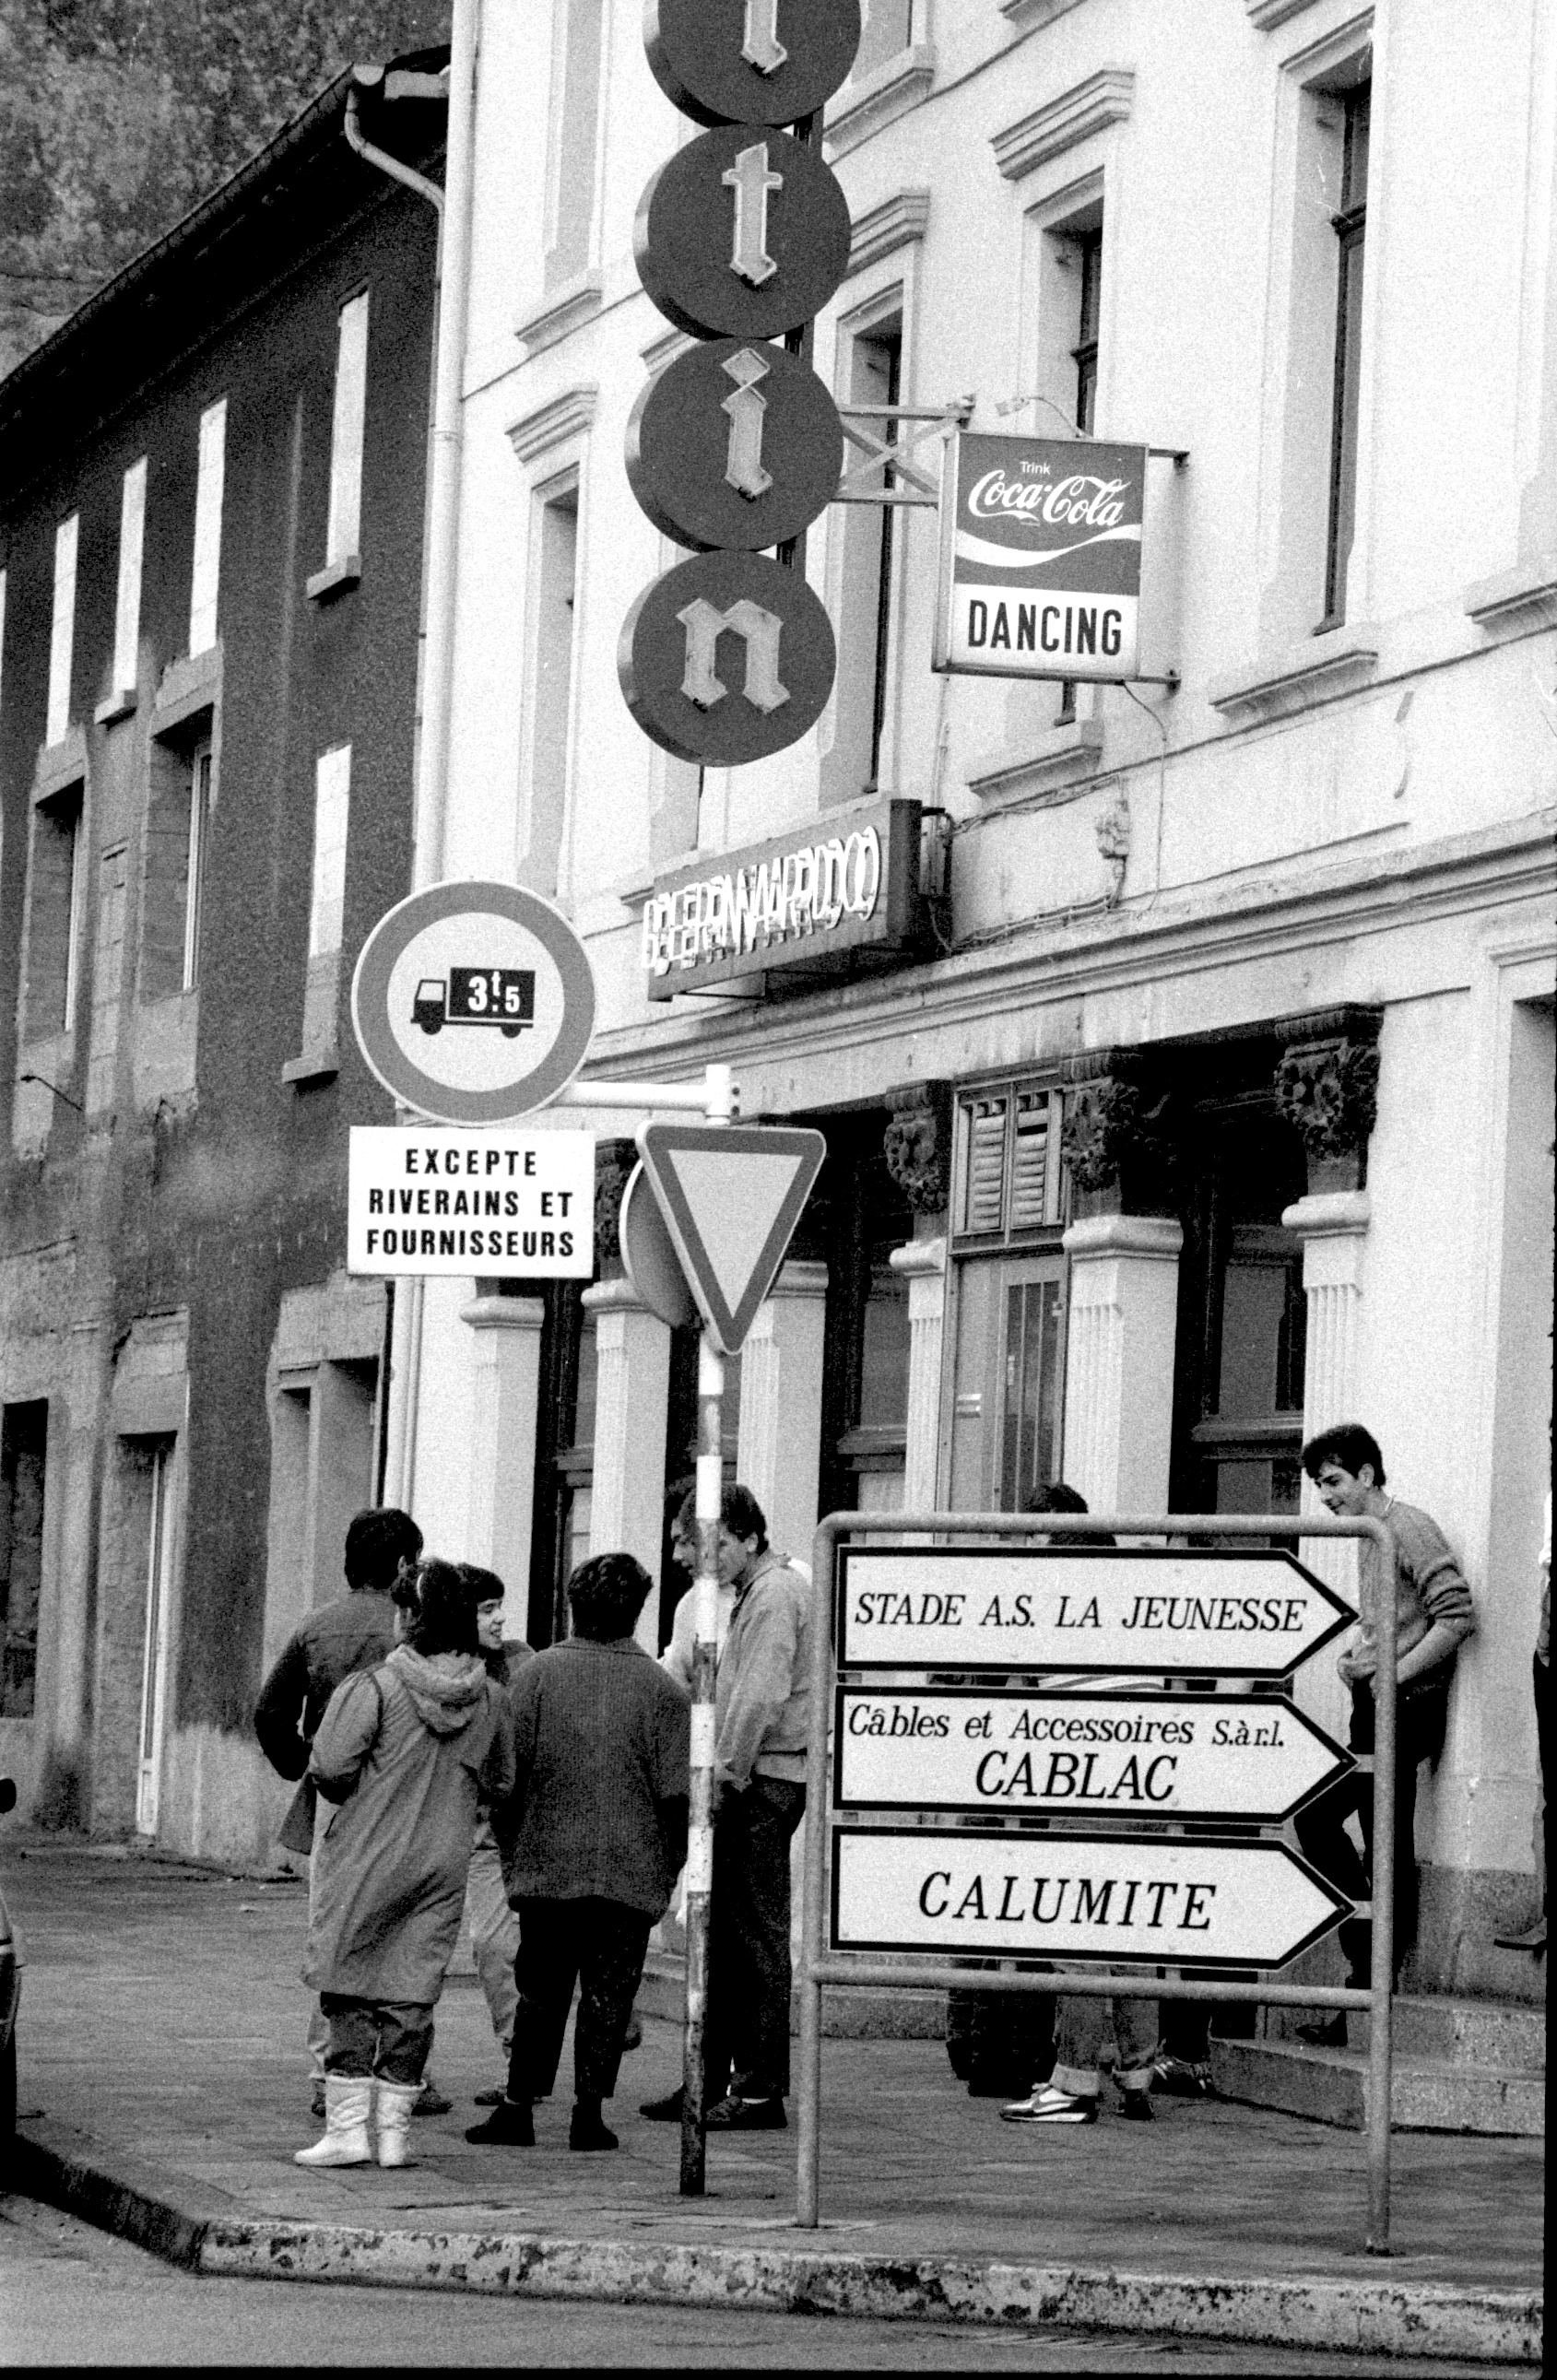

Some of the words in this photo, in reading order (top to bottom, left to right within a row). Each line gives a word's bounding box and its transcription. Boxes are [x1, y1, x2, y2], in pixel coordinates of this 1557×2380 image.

[1020, 461, 1051, 476] Trink
[969, 601, 1121, 655] DANCING
[407, 1149, 535, 1175] EXCEPTE
[370, 1189, 517, 1216] RIVERAINS
[542, 1193, 572, 1217] ET
[368, 1230, 572, 1256] FOURNISSEURS
[855, 1593, 965, 1625] STADE
[980, 1596, 1034, 1626] A.S.
[1056, 1596, 1101, 1627] LA
[1122, 1596, 1306, 1631] JEUNESSE
[849, 1704, 950, 1737] Câbles
[965, 1712, 991, 1738] et
[1009, 1710, 1194, 1743] Accessoires
[976, 1750, 1177, 1801] CABLAC
[919, 1872, 1216, 1929] CALUMITE
